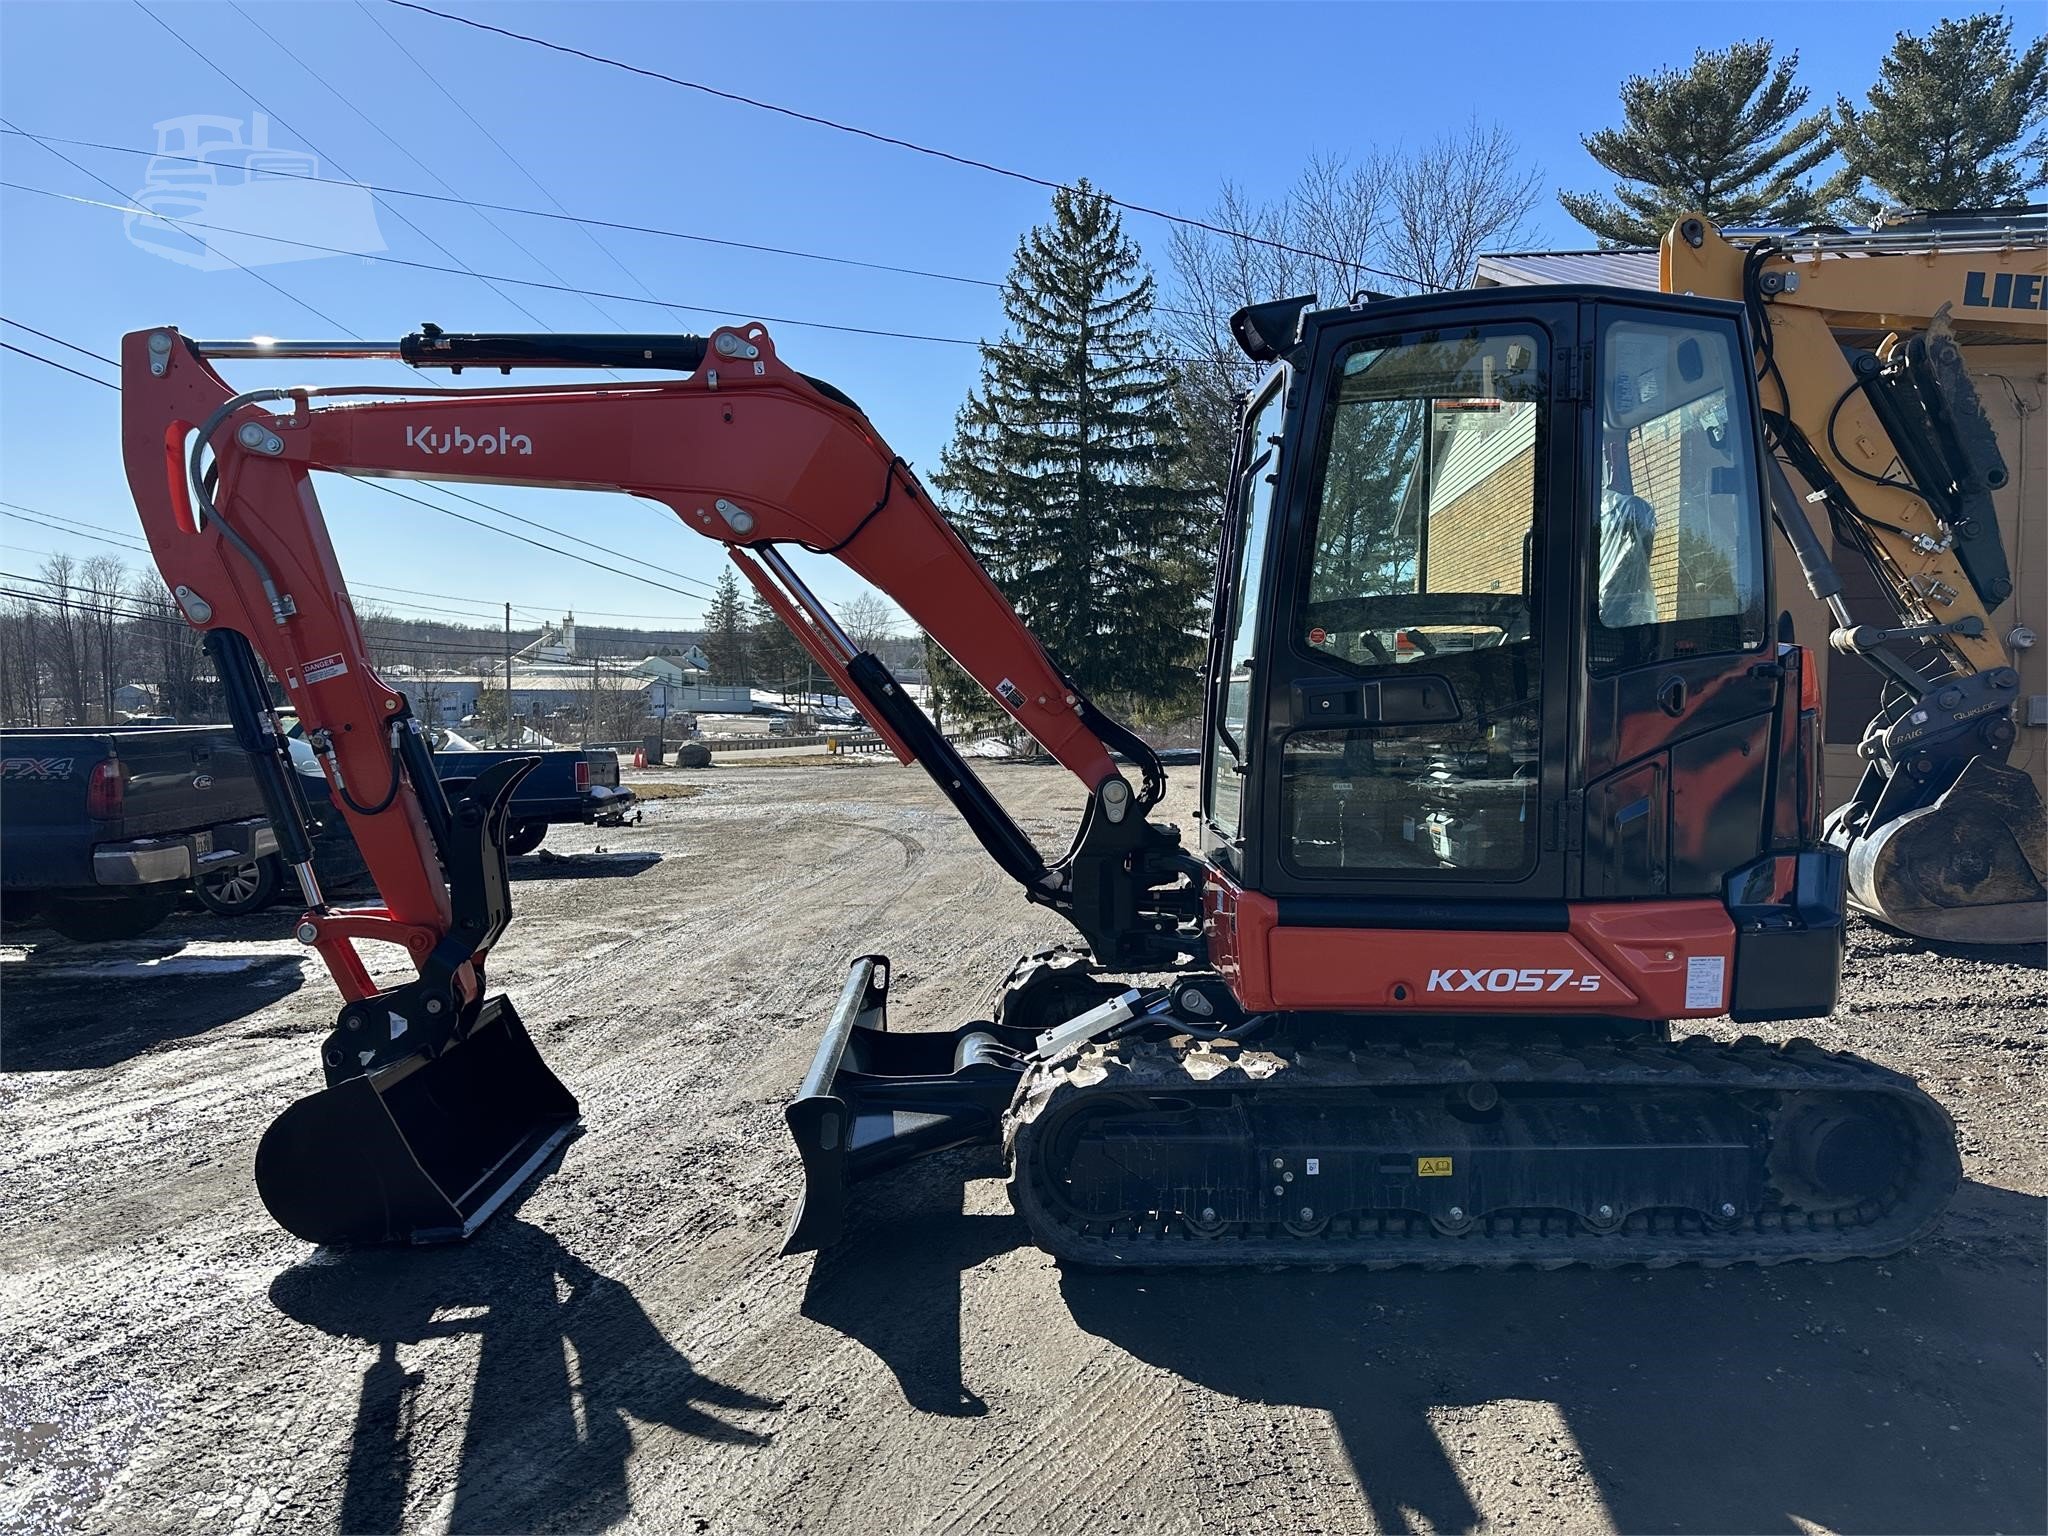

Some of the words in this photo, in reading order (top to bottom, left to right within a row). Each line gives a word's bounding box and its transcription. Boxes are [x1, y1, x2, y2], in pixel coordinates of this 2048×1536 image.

[1963, 271, 2048, 310] LIE
[406, 426, 532, 454] Kubota
[304, 659, 335, 673] DANGER
[0, 757, 75, 776] FX4
[1426, 969, 1601, 992] KX057-5
